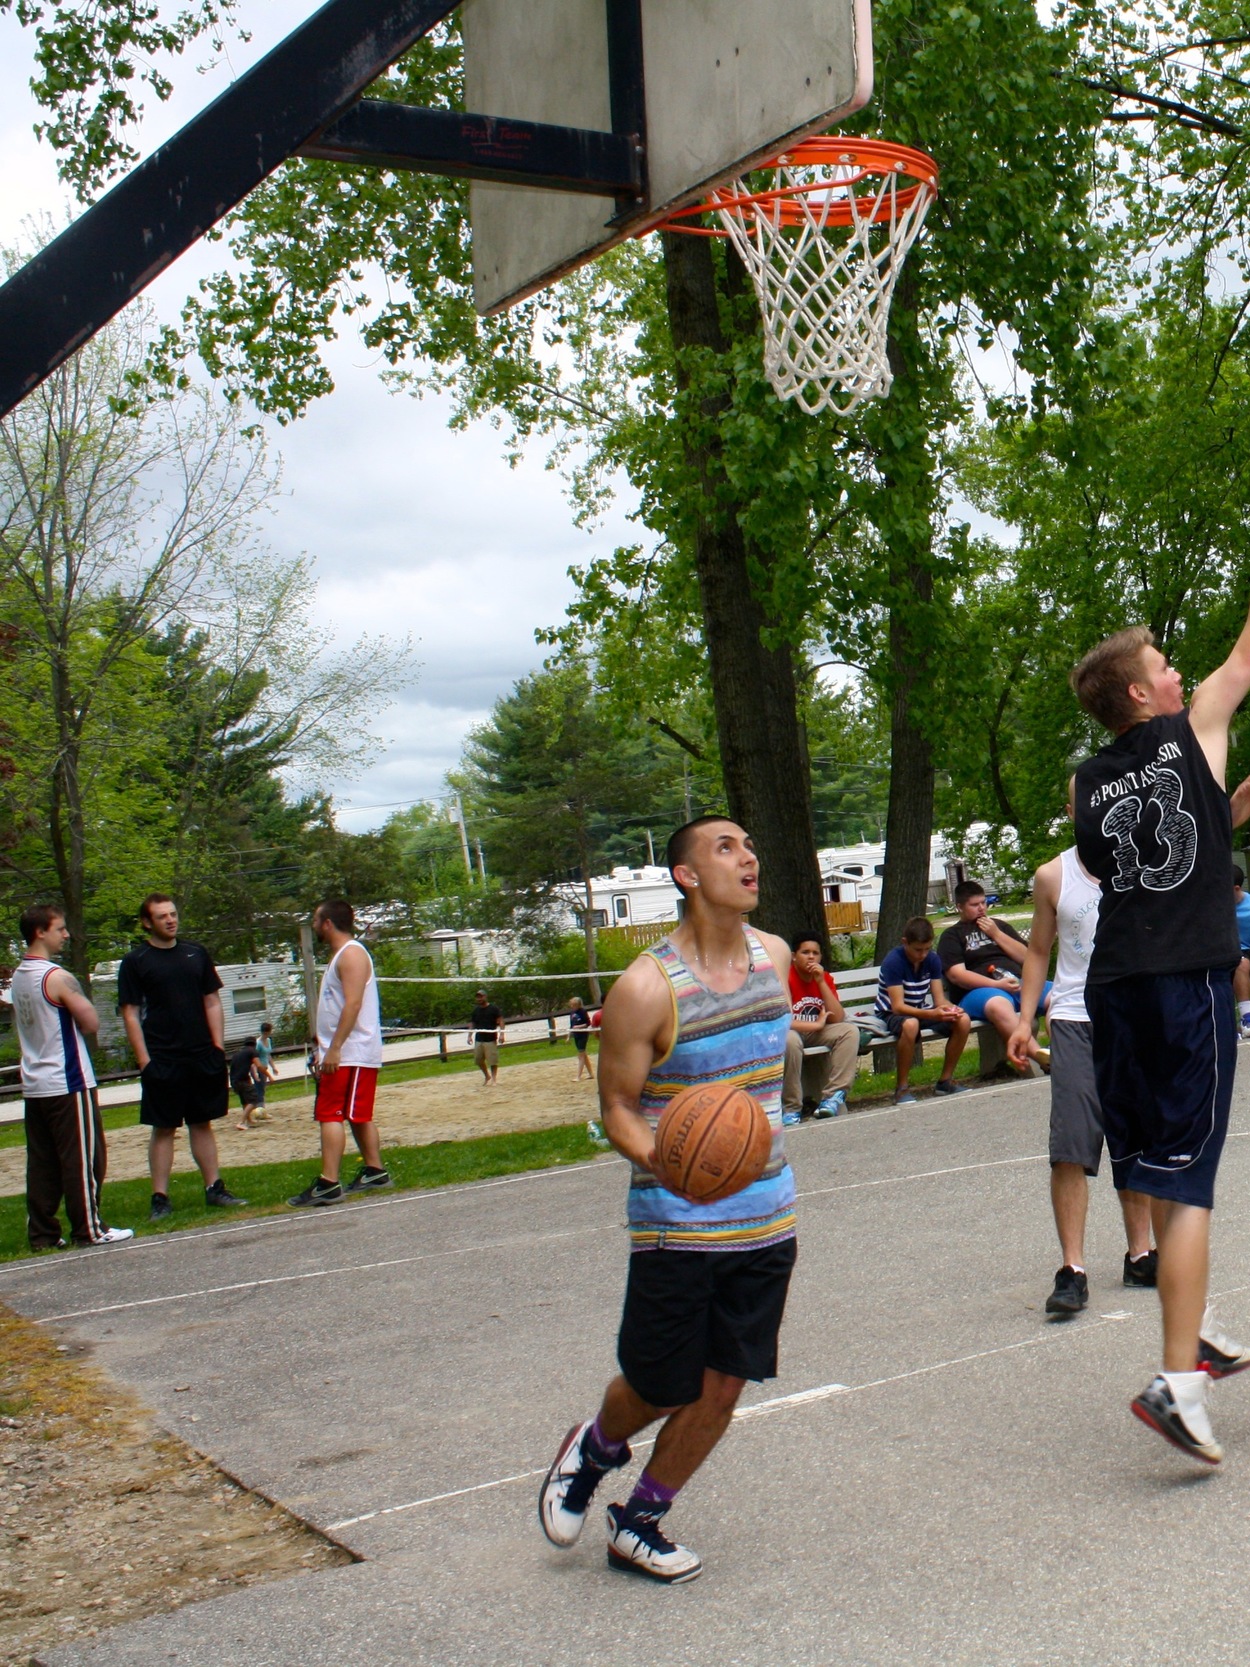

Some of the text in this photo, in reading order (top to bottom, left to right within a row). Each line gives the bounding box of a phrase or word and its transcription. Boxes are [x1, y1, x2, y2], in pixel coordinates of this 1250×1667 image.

[498, 126, 532, 141] Team
[1101, 772, 1140, 801] POINT
[1101, 768, 1198, 892] 13
[1072, 898, 1100, 923] VOLCO
[667, 1093, 716, 1169] SPALDING
